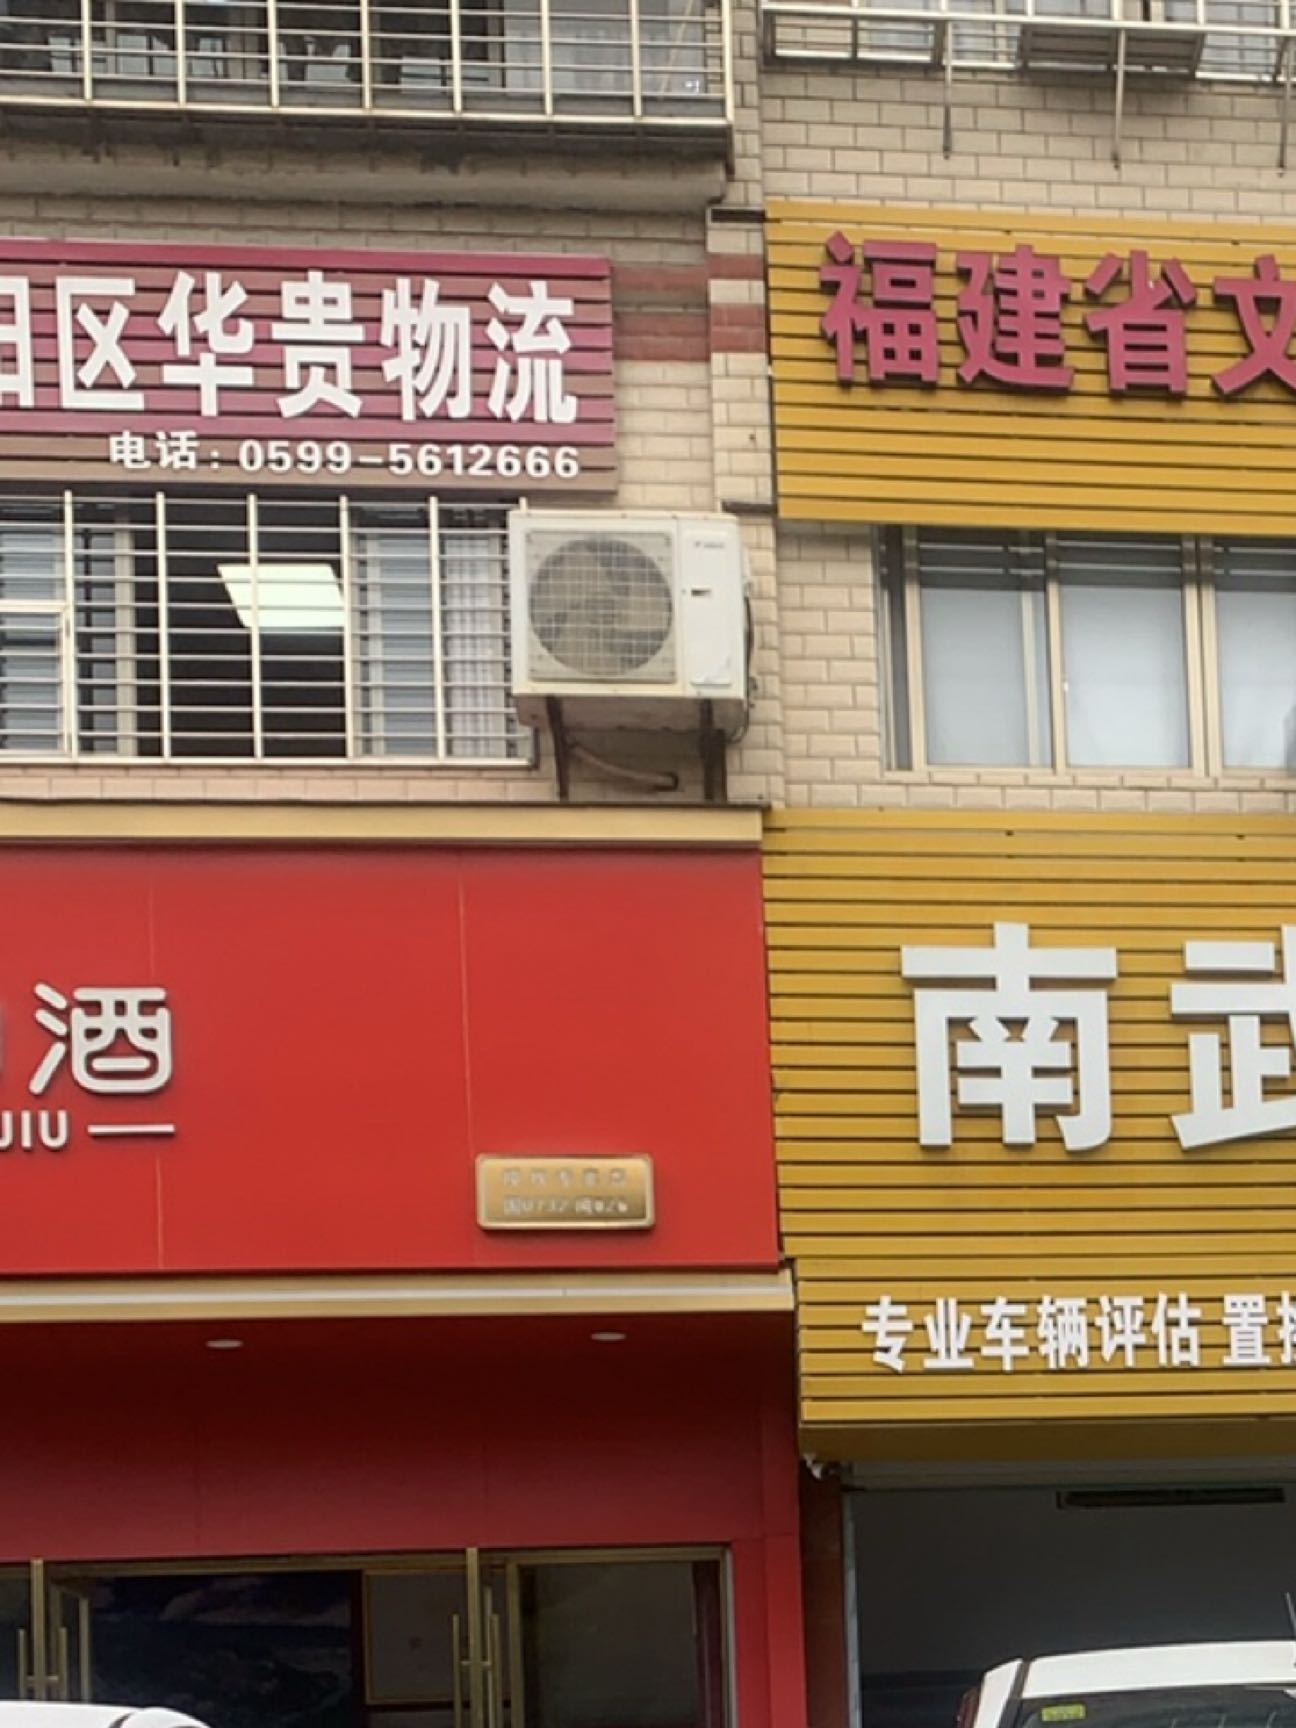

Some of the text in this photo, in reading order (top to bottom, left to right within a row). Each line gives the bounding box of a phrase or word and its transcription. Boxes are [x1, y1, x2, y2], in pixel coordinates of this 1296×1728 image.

[29, 983, 172, 1094] 酒
[861, 1293, 1200, 1372] 专业车辆评估
